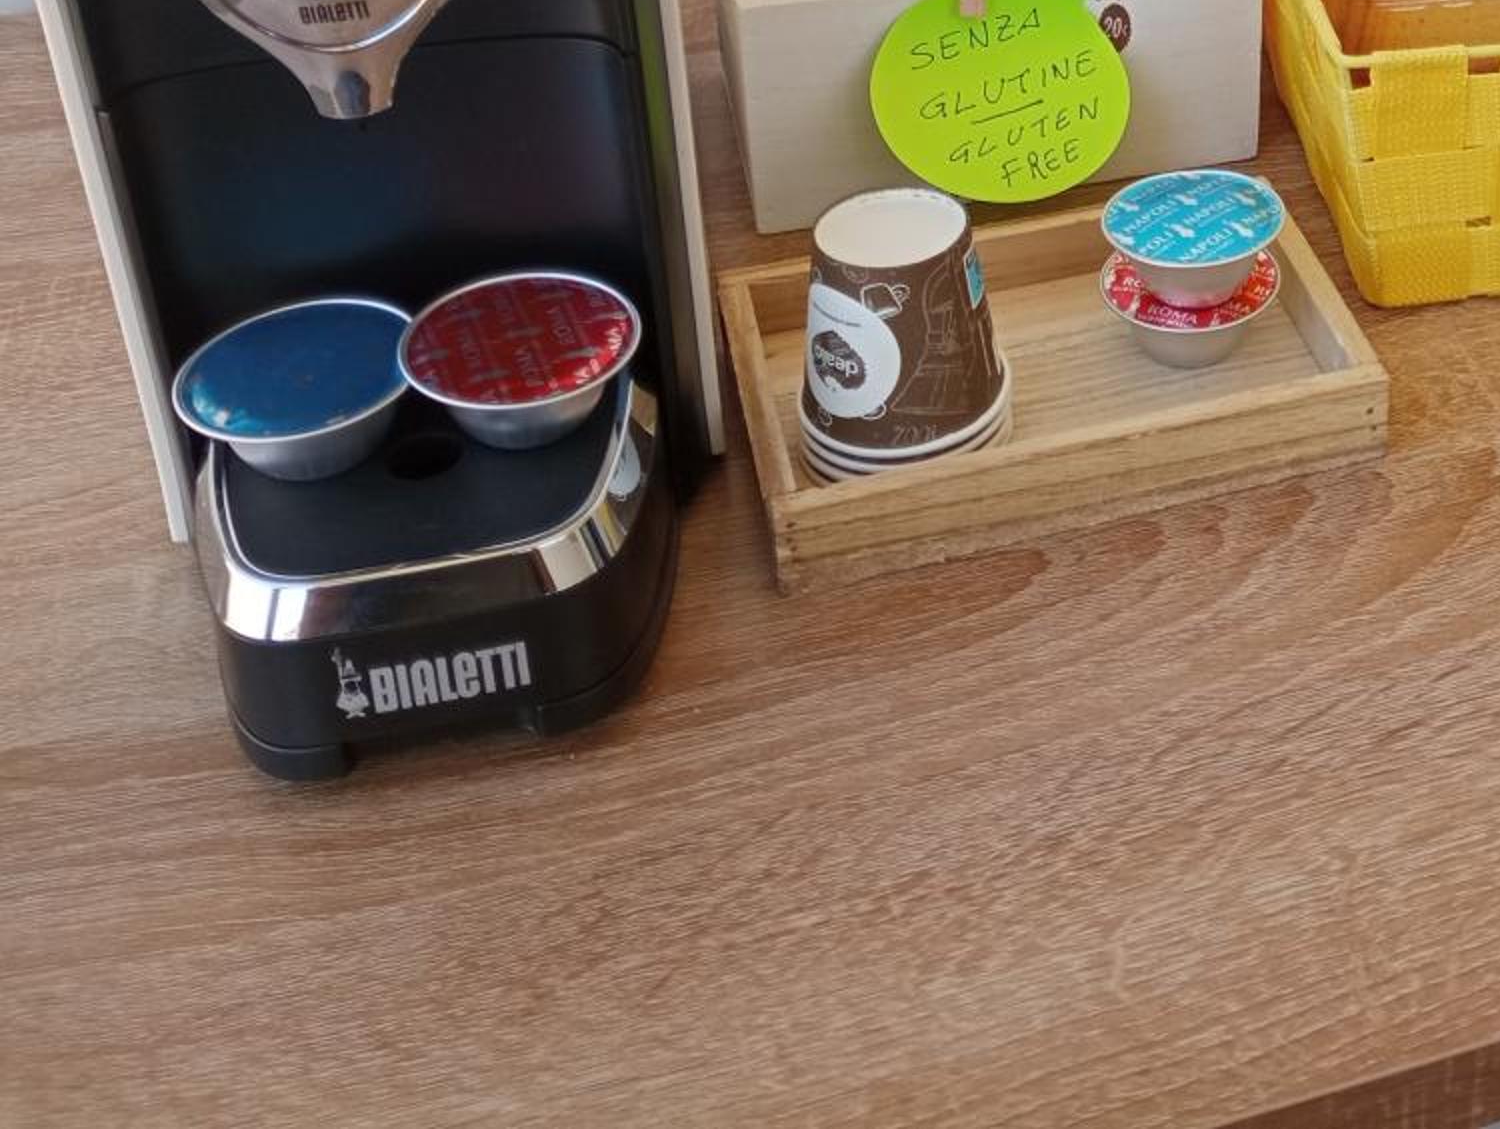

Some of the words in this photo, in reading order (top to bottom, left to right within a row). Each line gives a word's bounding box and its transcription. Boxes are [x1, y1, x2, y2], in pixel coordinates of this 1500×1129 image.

[911, 7, 1041, 71] SENZA
[919, 49, 1097, 120] GLUTINE
[949, 97, 1099, 164] GLUTEN
[1001, 138, 1080, 188] FREE
[1146, 305, 1199, 326] ROMA
